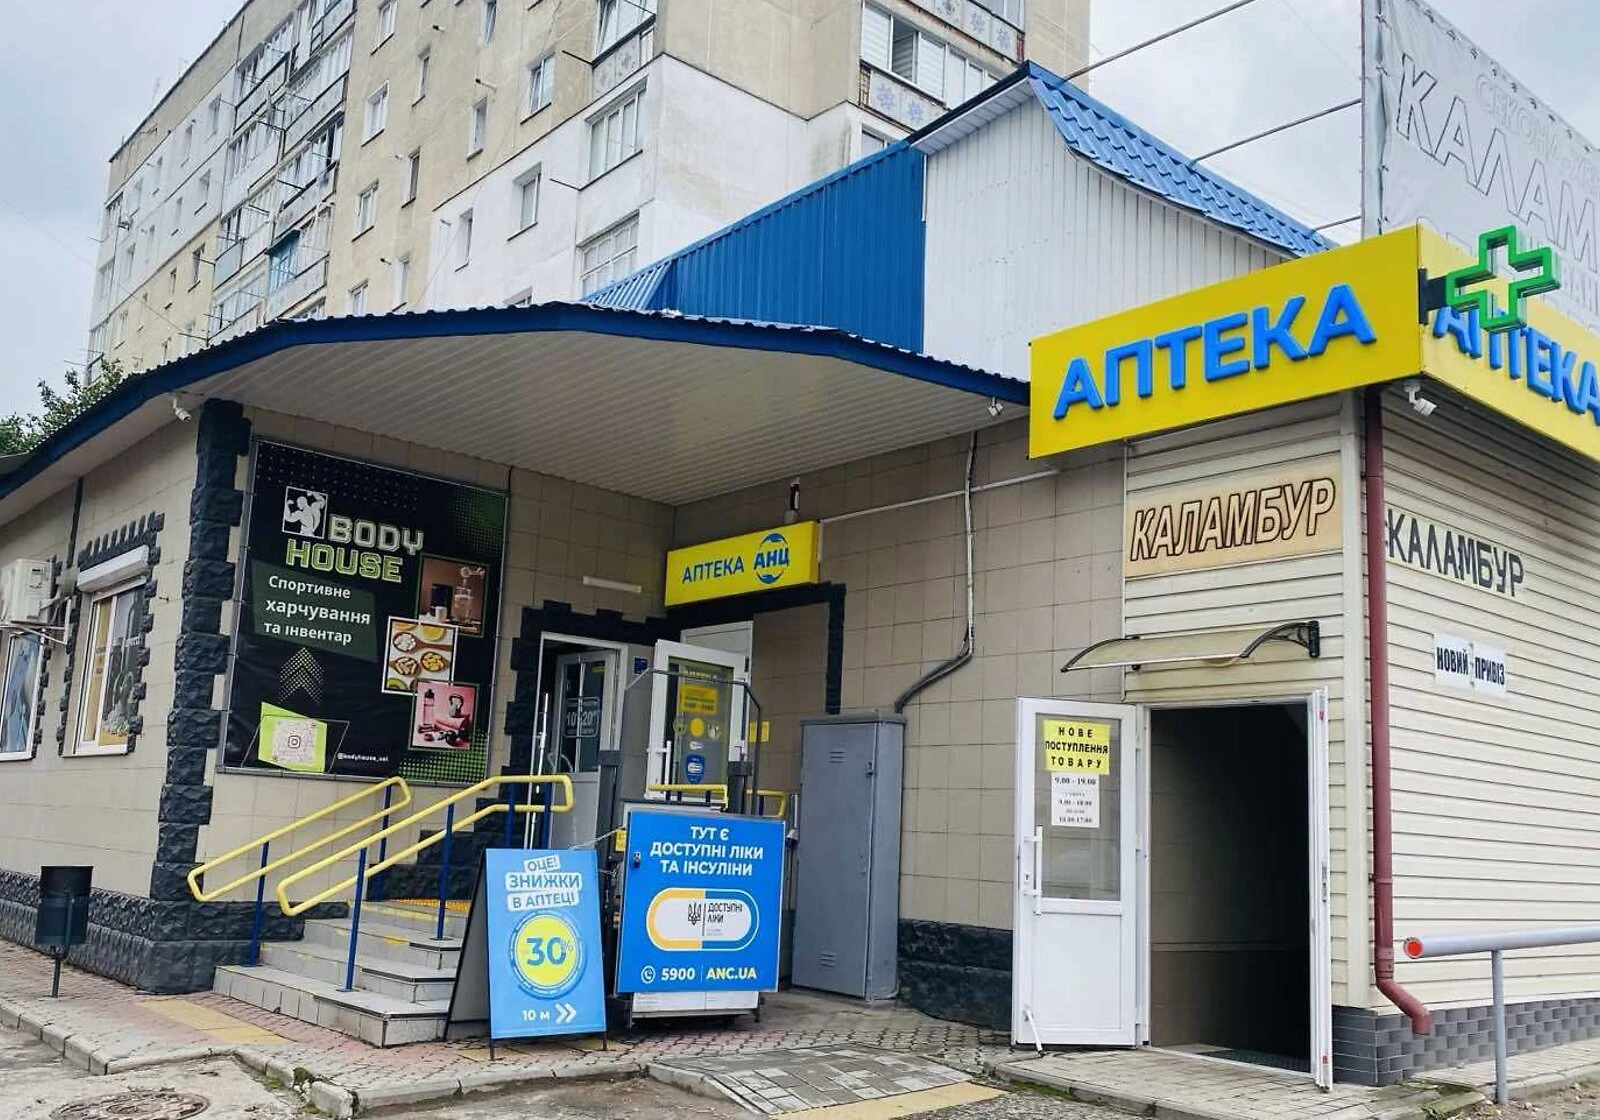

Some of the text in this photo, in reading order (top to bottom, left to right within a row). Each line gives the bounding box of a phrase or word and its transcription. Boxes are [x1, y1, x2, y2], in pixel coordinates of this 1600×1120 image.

[1053, 283, 1378, 420] АПТЕКА
[1130, 477, 1336, 562] КАЛАМБУР
[328, 513, 424, 555] BODY
[286, 538, 403, 583] HOUSE
[1388, 508, 1525, 597] КАЛАМБУР
[682, 547, 790, 584] АПТЕКА АНЦ
[268, 575, 351, 599] Спортивне
[265, 600, 371, 625] харчування
[264, 621, 352, 646] та інвентар
[1436, 645, 1506, 685] НОВИЙ ПРИВІЗ
[1059, 727, 1093, 738] НОВЕ
[1045, 741, 1109, 754] ПОСТУПЛЕННЯ
[1051, 756, 1102, 768] ТОВАРУ
[690, 826, 730, 841] ТУТ Є
[650, 842, 764, 860] ДОСТУПНІ ЛІКИ
[527, 856, 557, 872] ОЦЕ!
[660, 859, 753, 876] ТА ІНСУЛІНИ
[508, 874, 580, 889] ЗНИЖКИ
[512, 897, 522, 909] В
[707, 902, 743, 913] ДОСТУПНІ
[707, 914, 724, 923] ЛІКИ
[661, 967, 758, 981] 5900 ANC.UA
[522, 1009, 536, 1021] 10
